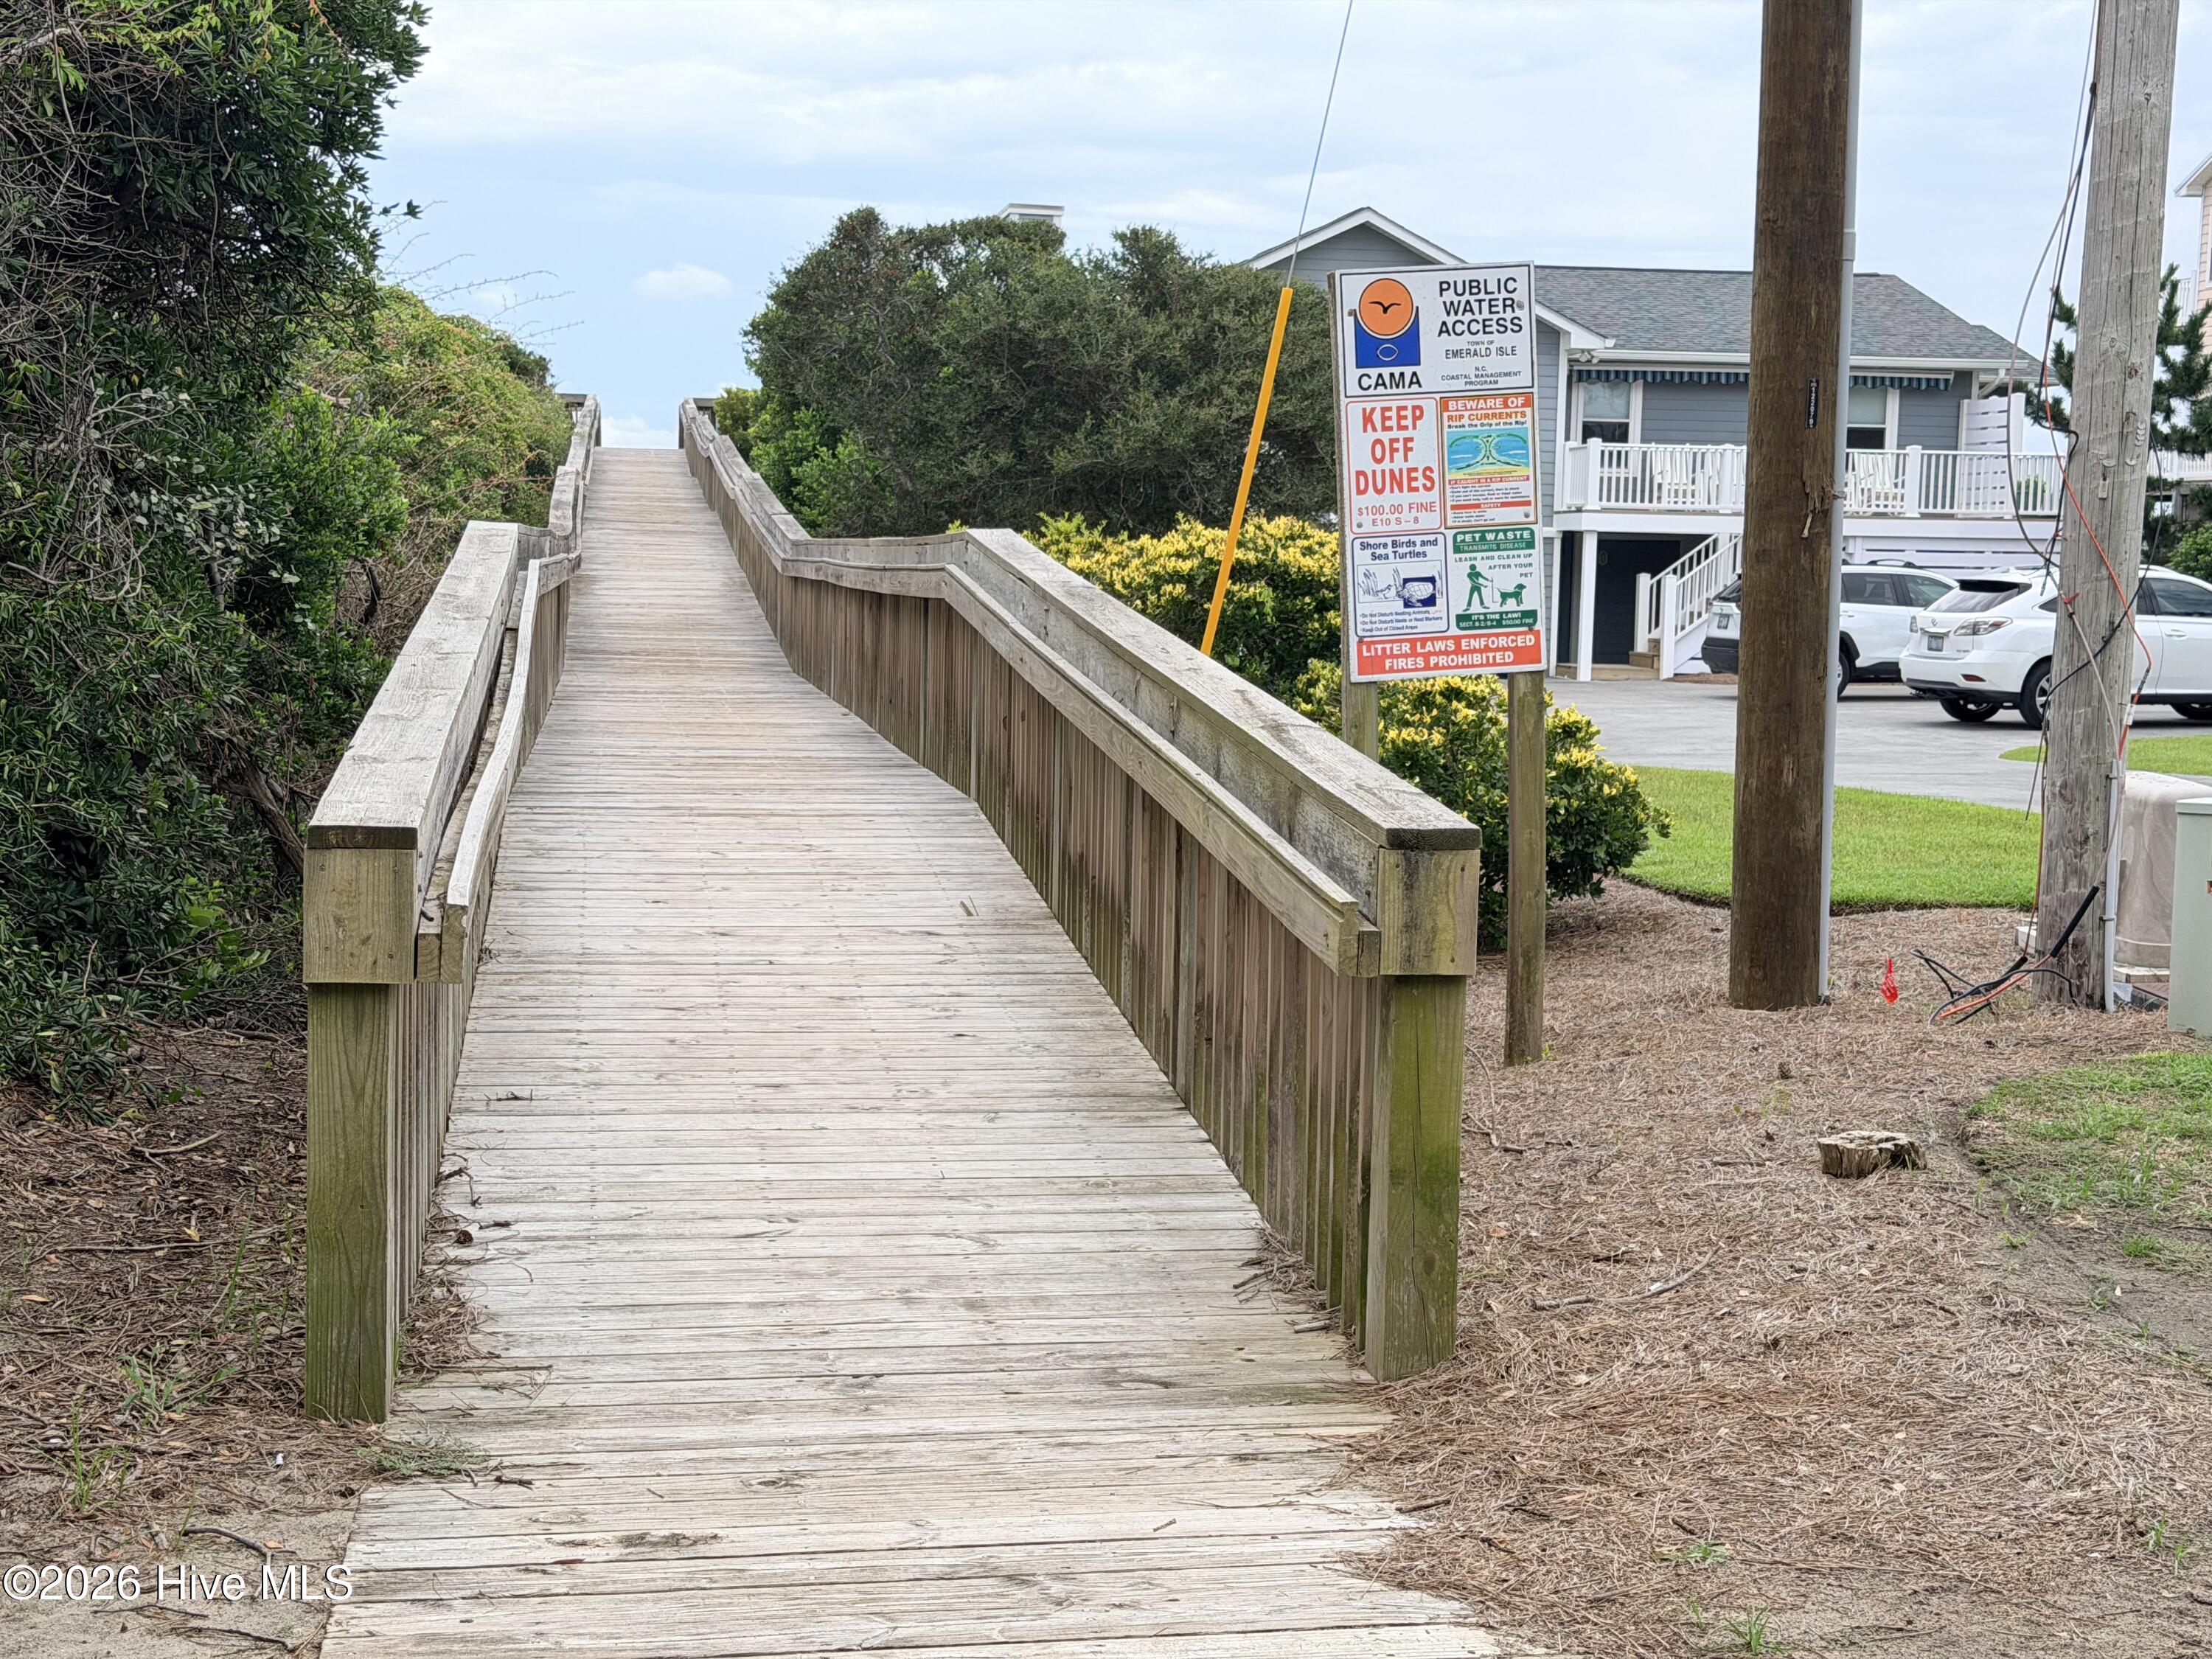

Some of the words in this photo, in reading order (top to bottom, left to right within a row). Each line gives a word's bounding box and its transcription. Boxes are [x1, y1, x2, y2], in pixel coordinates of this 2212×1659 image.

[1439, 276, 1517, 298] PUBLIC
[1442, 297, 1515, 317] WATER
[1437, 316, 1523, 337] ACCESS
[1445, 347, 1492, 359] EMERALD
[1495, 346, 1517, 356] ISLE
[1357, 371, 1423, 391] CAMA
[1475, 371, 1522, 379] MANAGEMENT
[1448, 398, 1504, 411] BEWARE
[1507, 397, 1526, 408] OF
[1362, 405, 1425, 434] KEEP
[1447, 414, 1465, 423] RIP
[1467, 410, 1527, 422] CURRENTS
[1371, 437, 1415, 465] OFF
[1355, 466, 1436, 495] DUNES
[1357, 504, 1404, 516] $100.00
[1408, 501, 1437, 513] FINE
[1371, 518, 1391, 526] E10
[1360, 540, 1388, 551] Shore
[1391, 538, 1417, 549] Birds
[1420, 537, 1438, 547] and
[1456, 533, 1481, 543] PET
[1485, 530, 1531, 541] WASTE
[1371, 552, 1389, 561] Sea
[1391, 549, 1427, 560] Turtles
[1362, 642, 1411, 657] LITTER
[1416, 640, 1455, 653] LAWS
[1461, 634, 1535, 650] ENFORCED
[1385, 657, 1425, 670] FIRES
[1429, 651, 1514, 667] PROHIBITED
